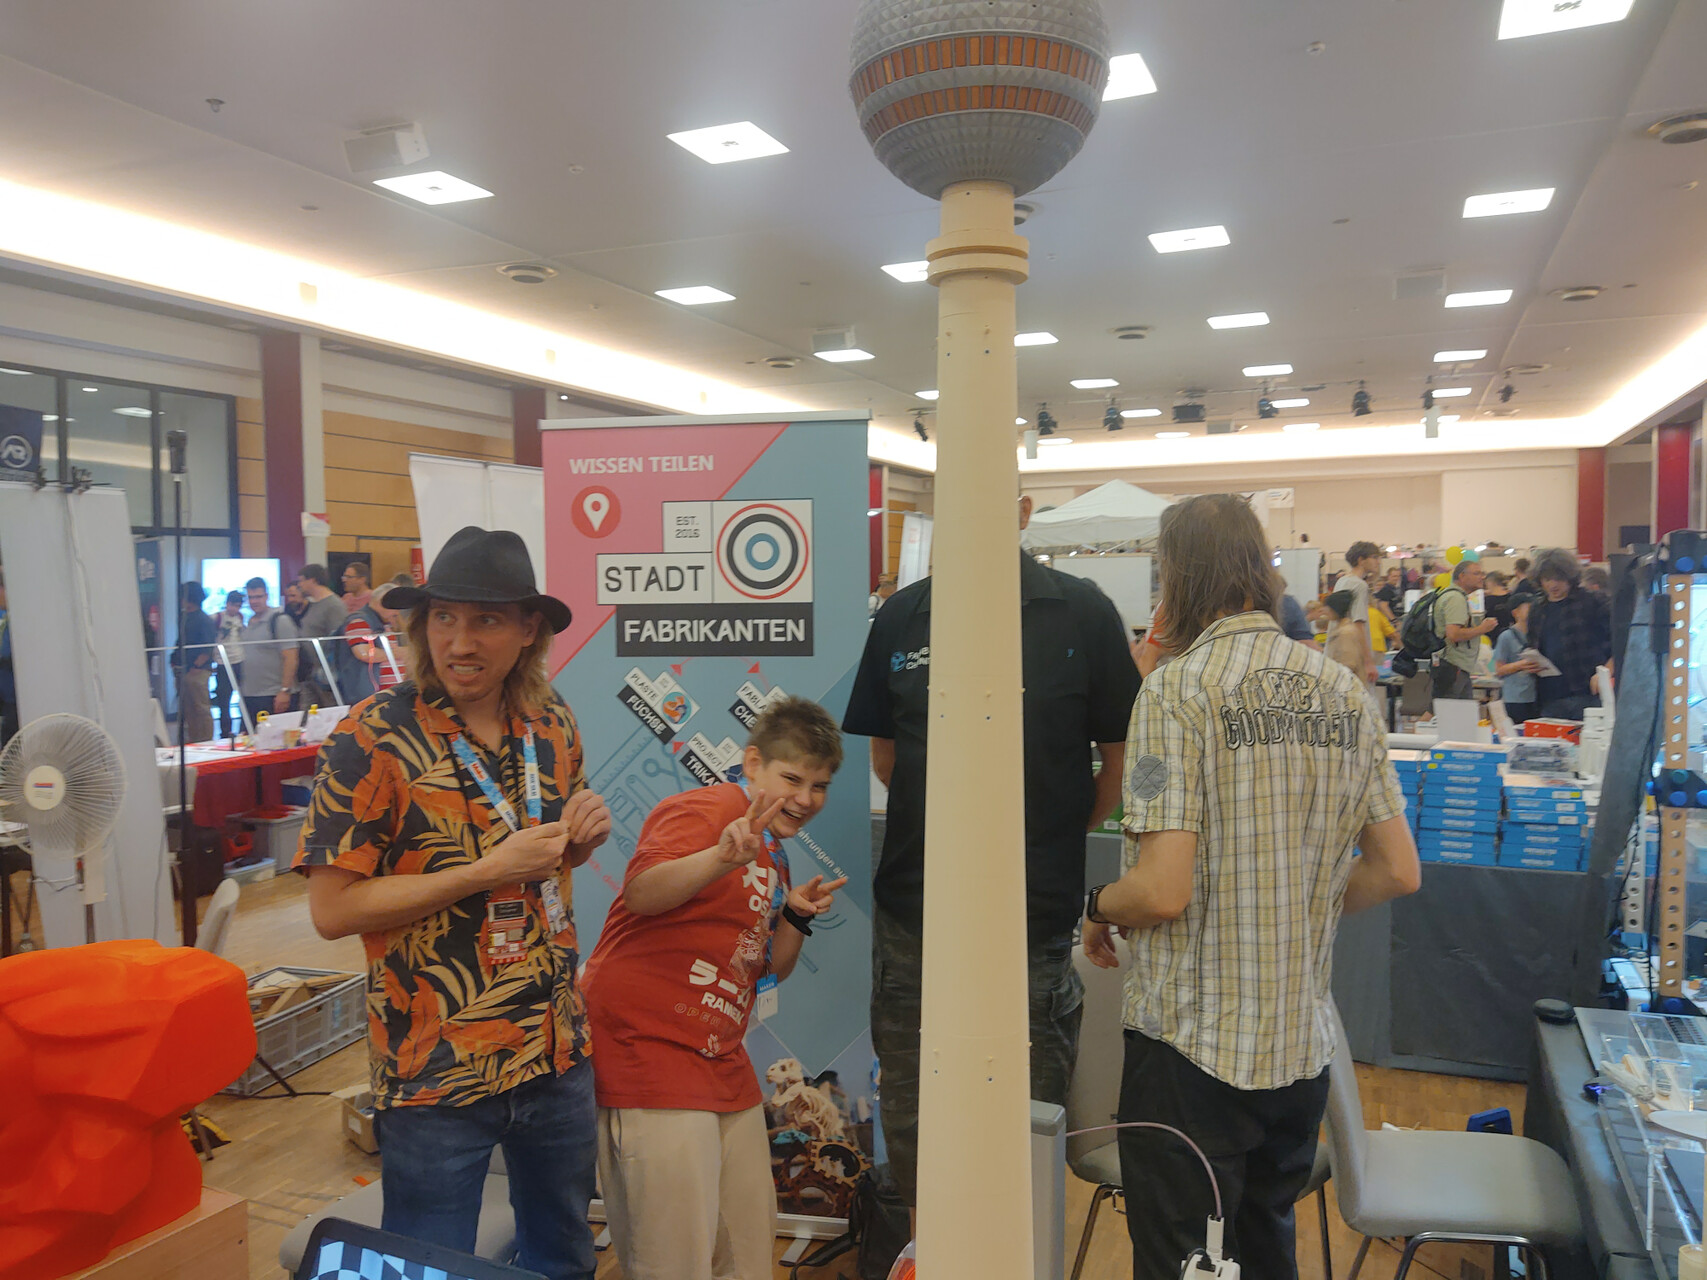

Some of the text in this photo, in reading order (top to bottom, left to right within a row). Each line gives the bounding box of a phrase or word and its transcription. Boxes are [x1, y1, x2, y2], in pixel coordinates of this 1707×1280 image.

[569, 455, 714, 474] WISSEN TEILEN
[676, 515, 700, 526] EST.
[604, 565, 705, 593] STADT
[624, 618, 805, 643] FABRIKANTEN
[741, 685, 768, 712] FABLA
[626, 694, 667, 735] FÜCHSE
[734, 705, 758, 728] CHE
[692, 736, 722, 767] PROJECT
[687, 755, 721, 787] TRIKA
[701, 991, 745, 1025] RAMEN
